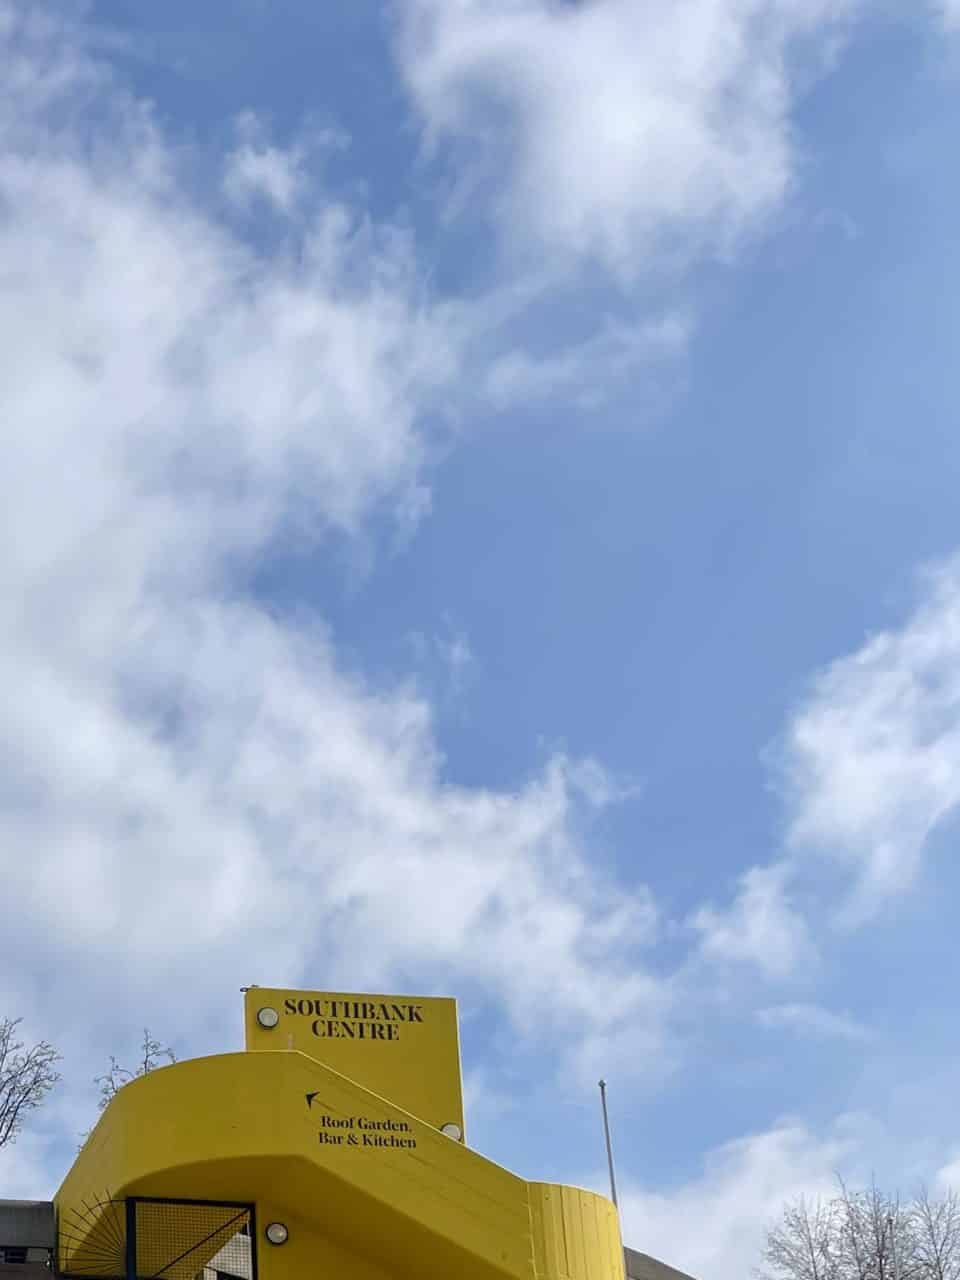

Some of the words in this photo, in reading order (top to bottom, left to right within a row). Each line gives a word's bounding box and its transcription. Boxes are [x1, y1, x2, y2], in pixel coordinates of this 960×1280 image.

[284, 999, 423, 1023] SOUTHBANK
[311, 1020, 400, 1041] CENTRE
[320, 1115, 355, 1129] Roof
[319, 1132, 344, 1145] Bar
[347, 1133, 359, 1145] &
[362, 1133, 417, 1148] Kitchen
